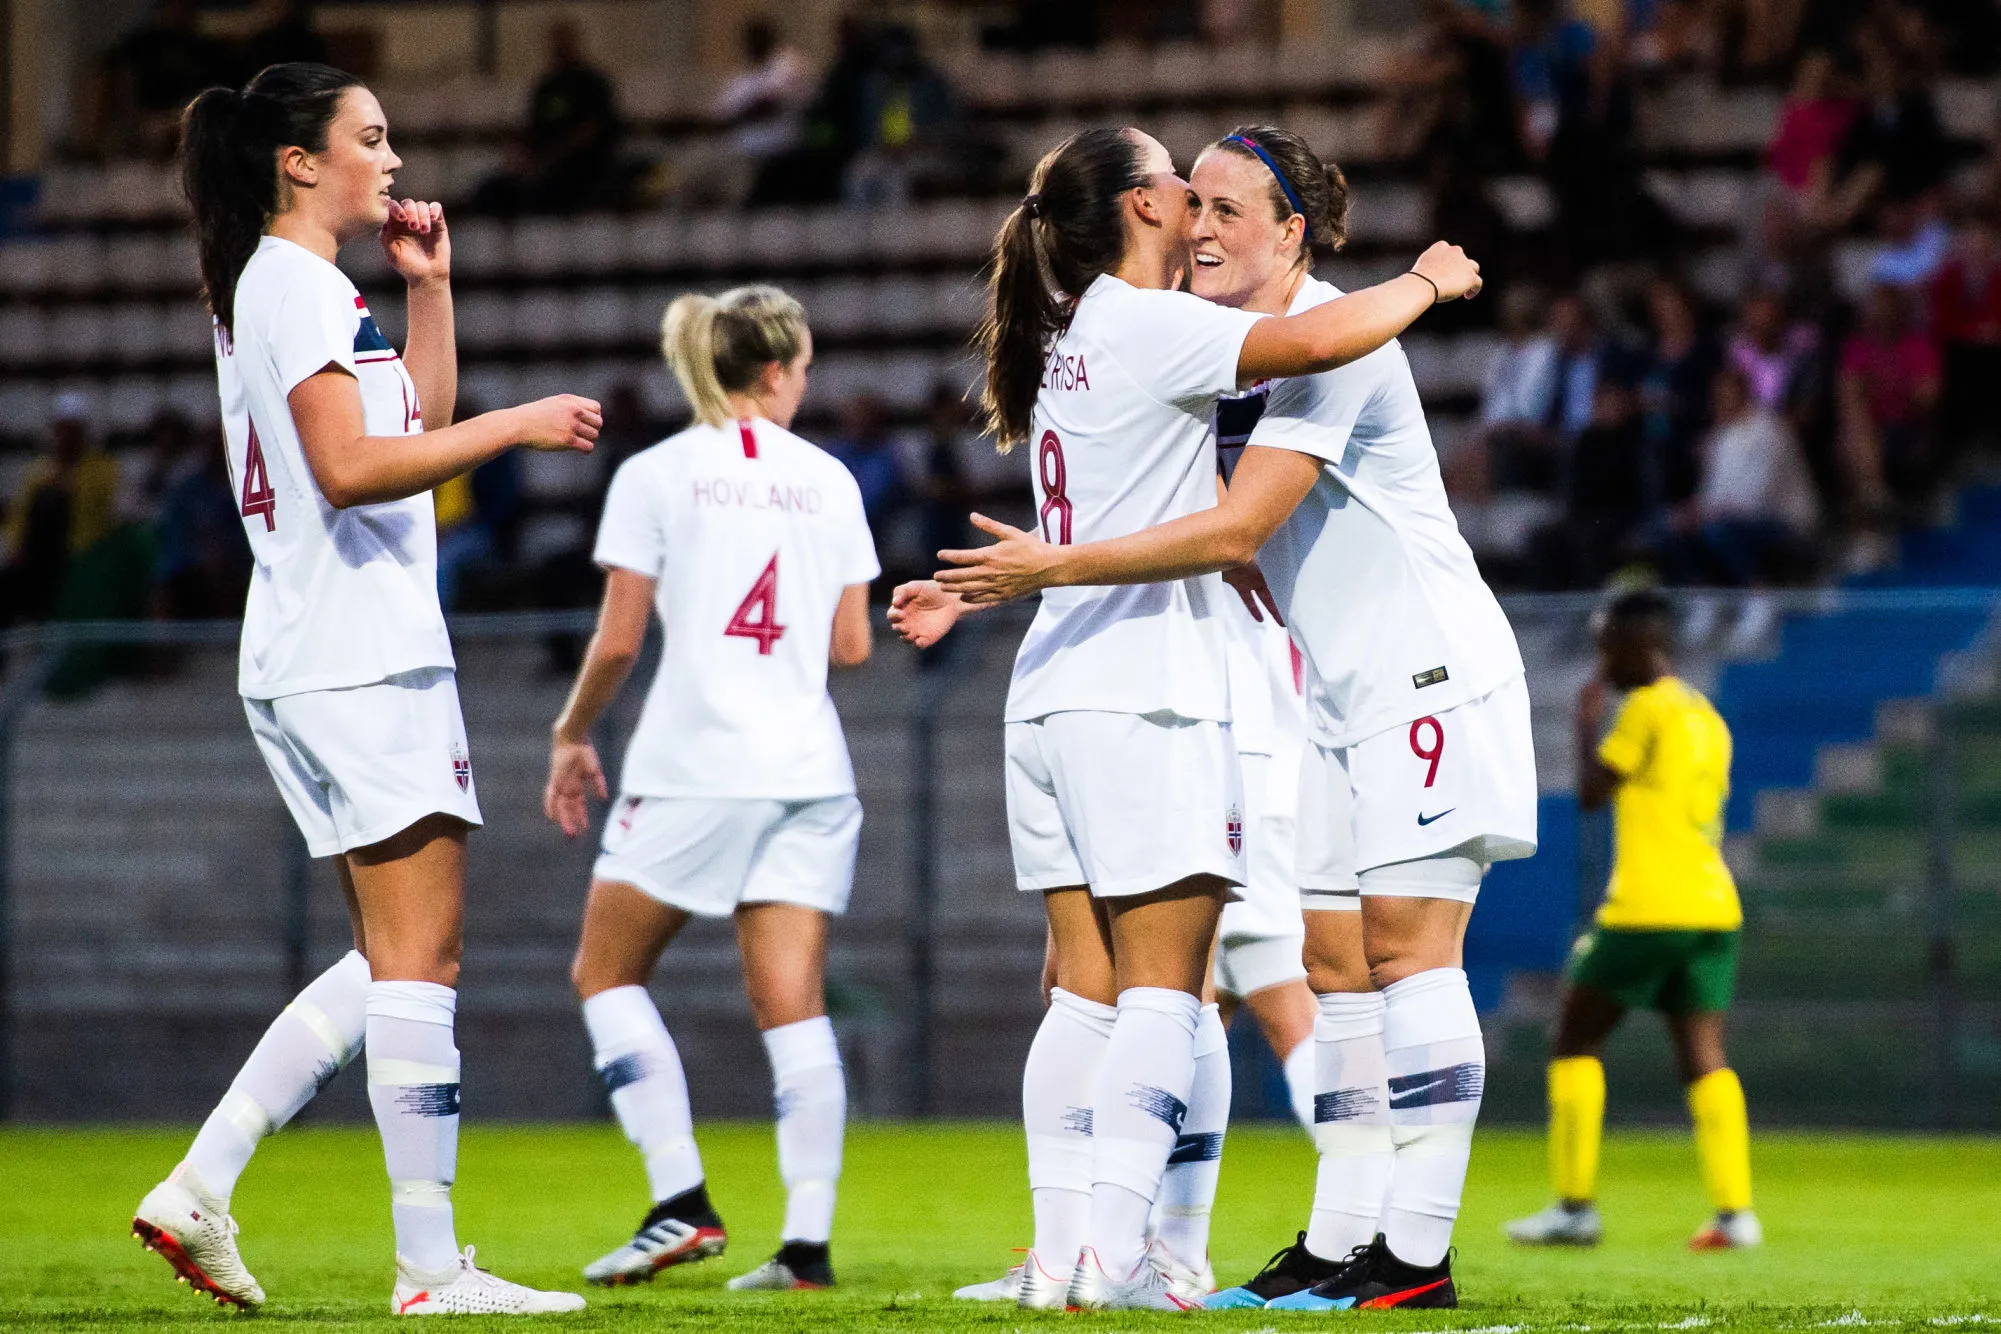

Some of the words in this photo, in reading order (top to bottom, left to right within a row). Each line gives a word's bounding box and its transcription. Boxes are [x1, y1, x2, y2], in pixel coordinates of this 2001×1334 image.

[1039, 429, 1073, 546] 8
[724, 547, 789, 656] 4
[1409, 715, 1444, 788] 9
